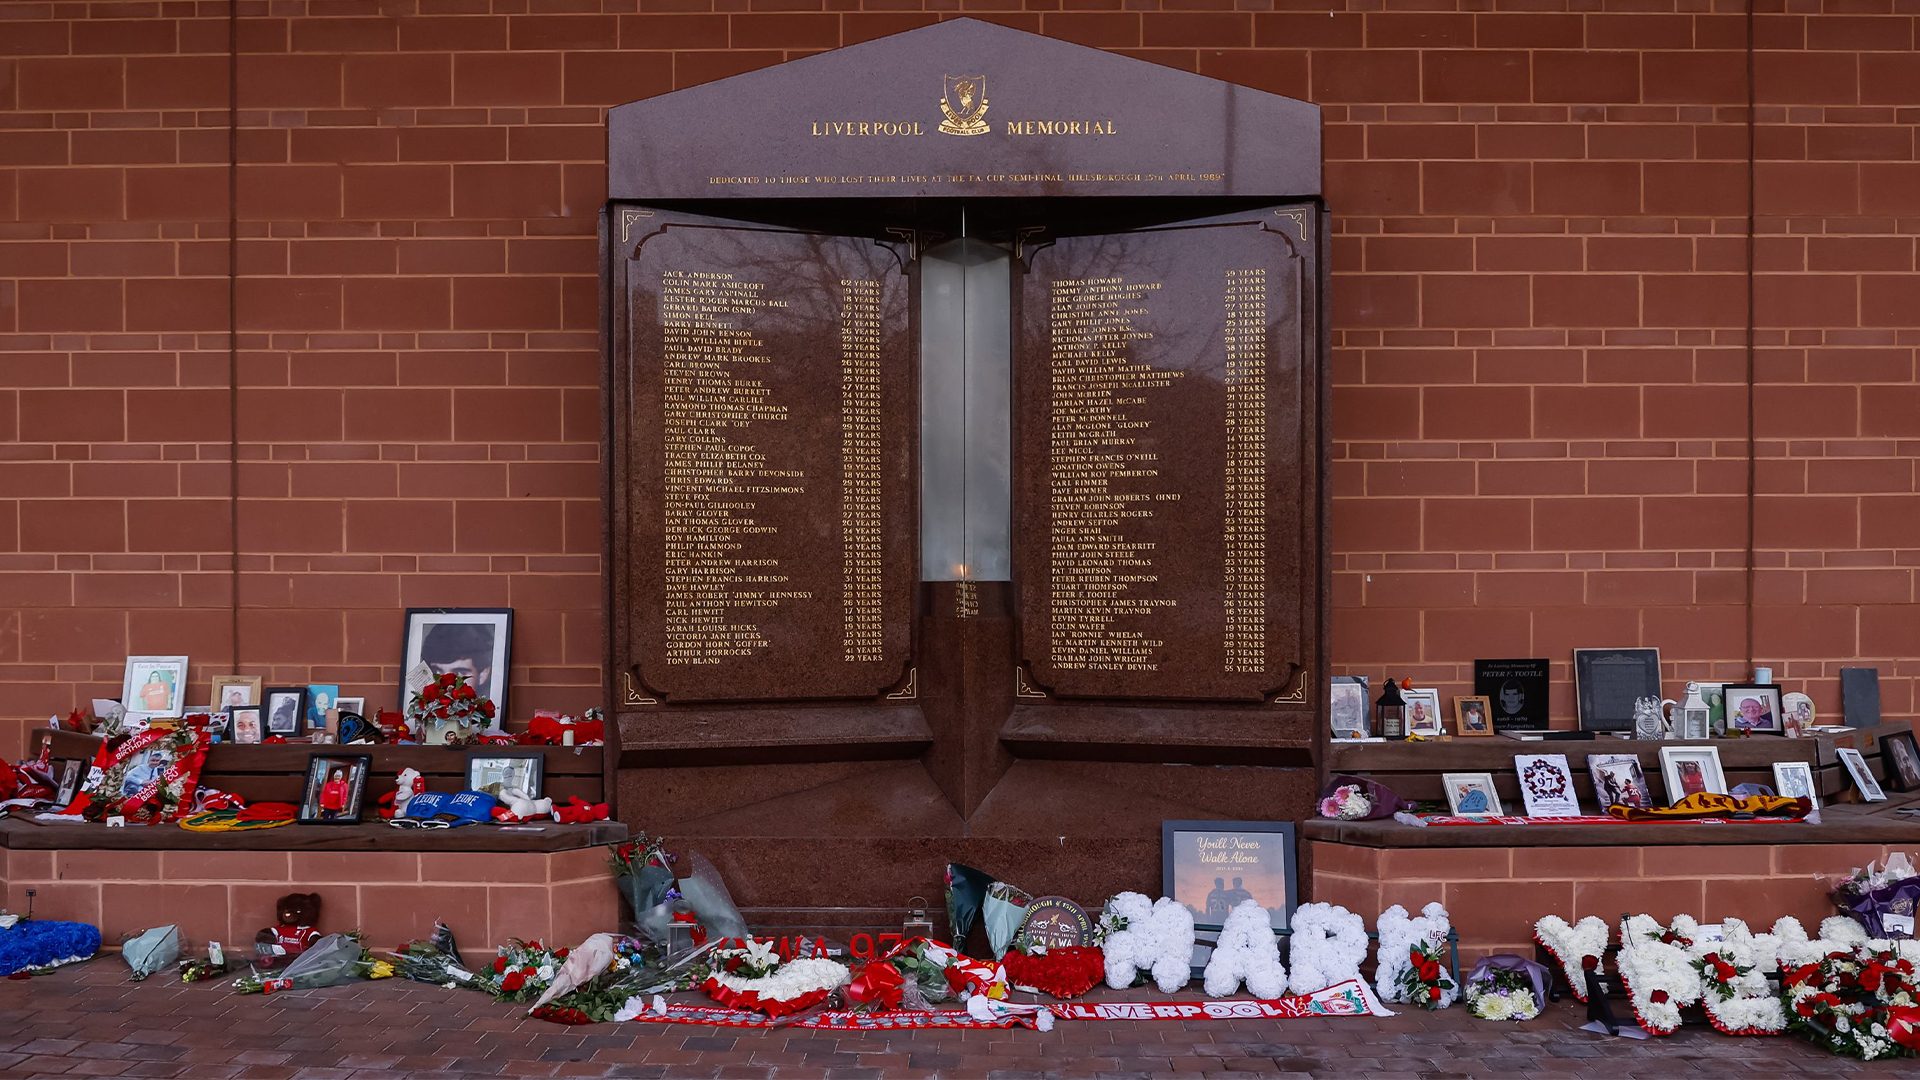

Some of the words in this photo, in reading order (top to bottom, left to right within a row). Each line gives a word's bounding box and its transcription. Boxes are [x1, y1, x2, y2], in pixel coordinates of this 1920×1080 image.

[811, 121, 925, 136] LIVERPOOL
[1006, 121, 1118, 135] MEMORIAL
[764, 176, 776, 184] TO
[780, 176, 810, 184] THOSE
[814, 176, 837, 184] WHO
[841, 176, 864, 184] LOST
[901, 175, 928, 183] LIVES
[931, 175, 942, 183] AT
[946, 175, 966, 183] THE
[1068, 174, 1140, 182] HILLSBOROUGH
[1168, 174, 1196, 182] APRIL
[116, 734, 152, 760] BIRTHDAY
[118, 734, 141, 752] HAPPY
[162, 764, 178, 778] FOR
[1537, 778, 1554, 788] 97
[414, 793, 442, 808] LEONE
[450, 792, 480, 807] LEONE
[1228, 836, 1261, 850] Never
[1199, 852, 1228, 864] Walk
[1228, 851, 1260, 864] Alone
[1429, 930, 1448, 942] LFC
[1074, 1002, 1282, 1019] LIVERPOOL
